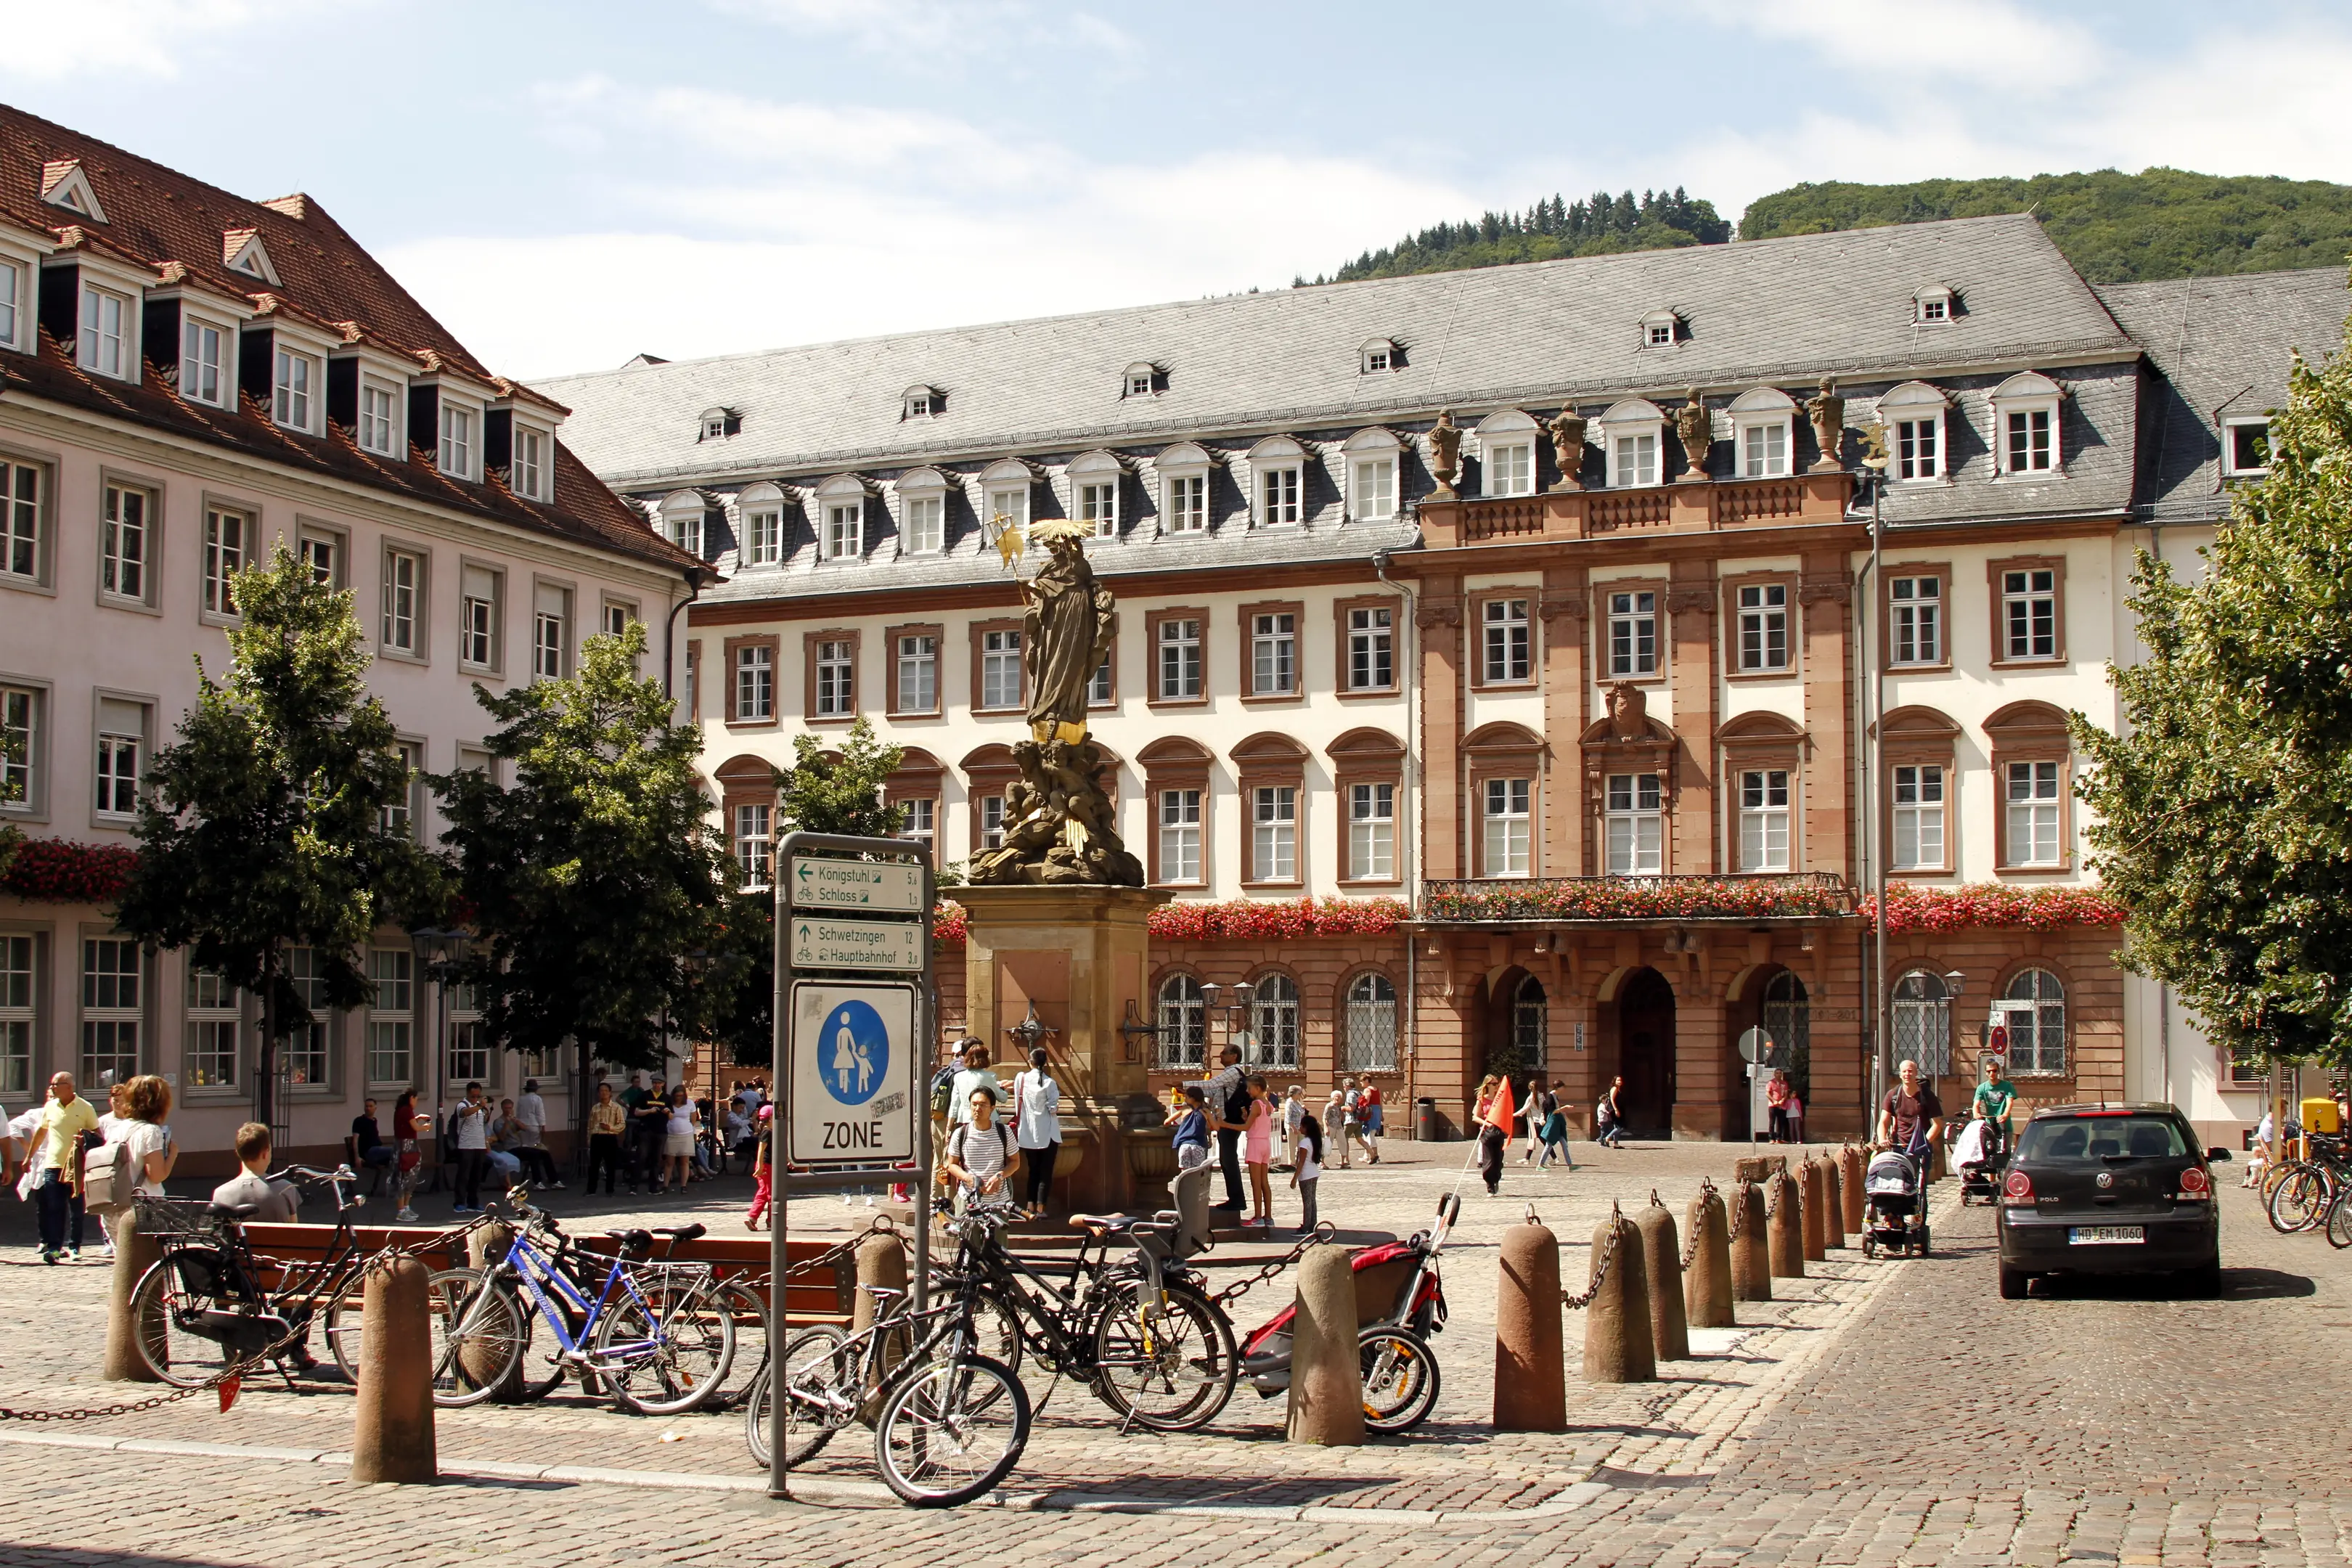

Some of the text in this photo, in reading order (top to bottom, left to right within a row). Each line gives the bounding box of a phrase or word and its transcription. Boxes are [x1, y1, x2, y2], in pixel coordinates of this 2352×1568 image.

[819, 866, 870, 884] Königstuhl
[819, 887, 857, 902] Schloss
[819, 926, 912, 946] Schwetzingen 12
[830, 948, 897, 965] Hauptbahnhof
[822, 1121, 883, 1149] ZONE
[2078, 1228, 2142, 1240] HD EM 1060
[520, 1269, 554, 1315] canyon
